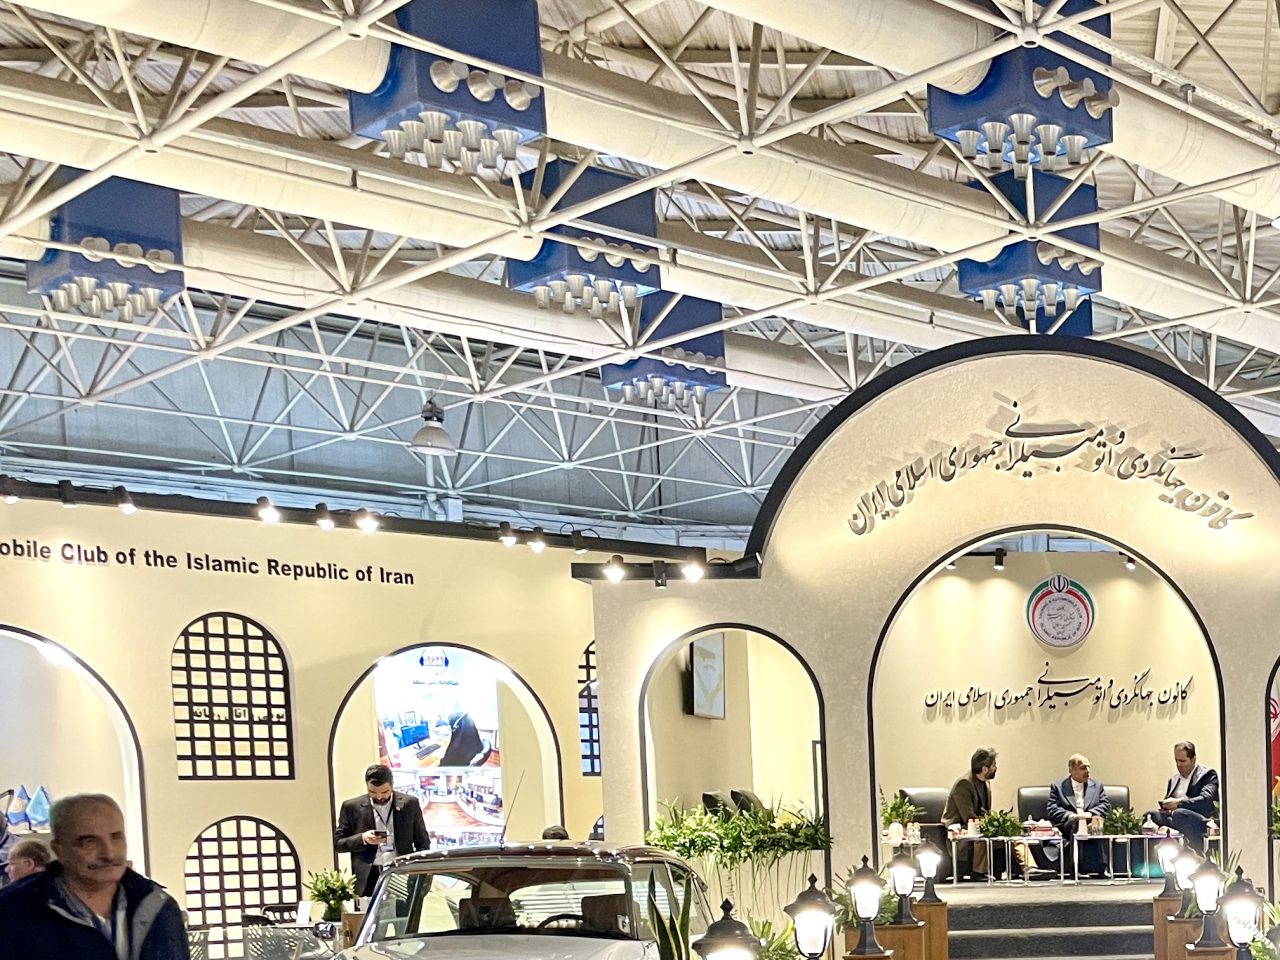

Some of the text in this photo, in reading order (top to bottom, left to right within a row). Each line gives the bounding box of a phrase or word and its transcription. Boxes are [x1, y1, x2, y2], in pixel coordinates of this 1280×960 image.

[1115, 430, 1126, 445] و
[939, 440, 1003, 482] جمهوری
[1117, 447, 1204, 504] جهانگردی
[887, 457, 934, 507] اسلامی
[848, 484, 891, 535] ایران
[1181, 488, 1254, 529] کانون
[0, 539, 415, 585] obile Club of the Islamic Republic of Iran
[925, 689, 955, 708] ایران
[958, 686, 992, 707] اسلامی
[994, 686, 1034, 709] جمهوری
[1109, 668, 1151, 708] جهانگردی
[1158, 675, 1194, 704] کانون
